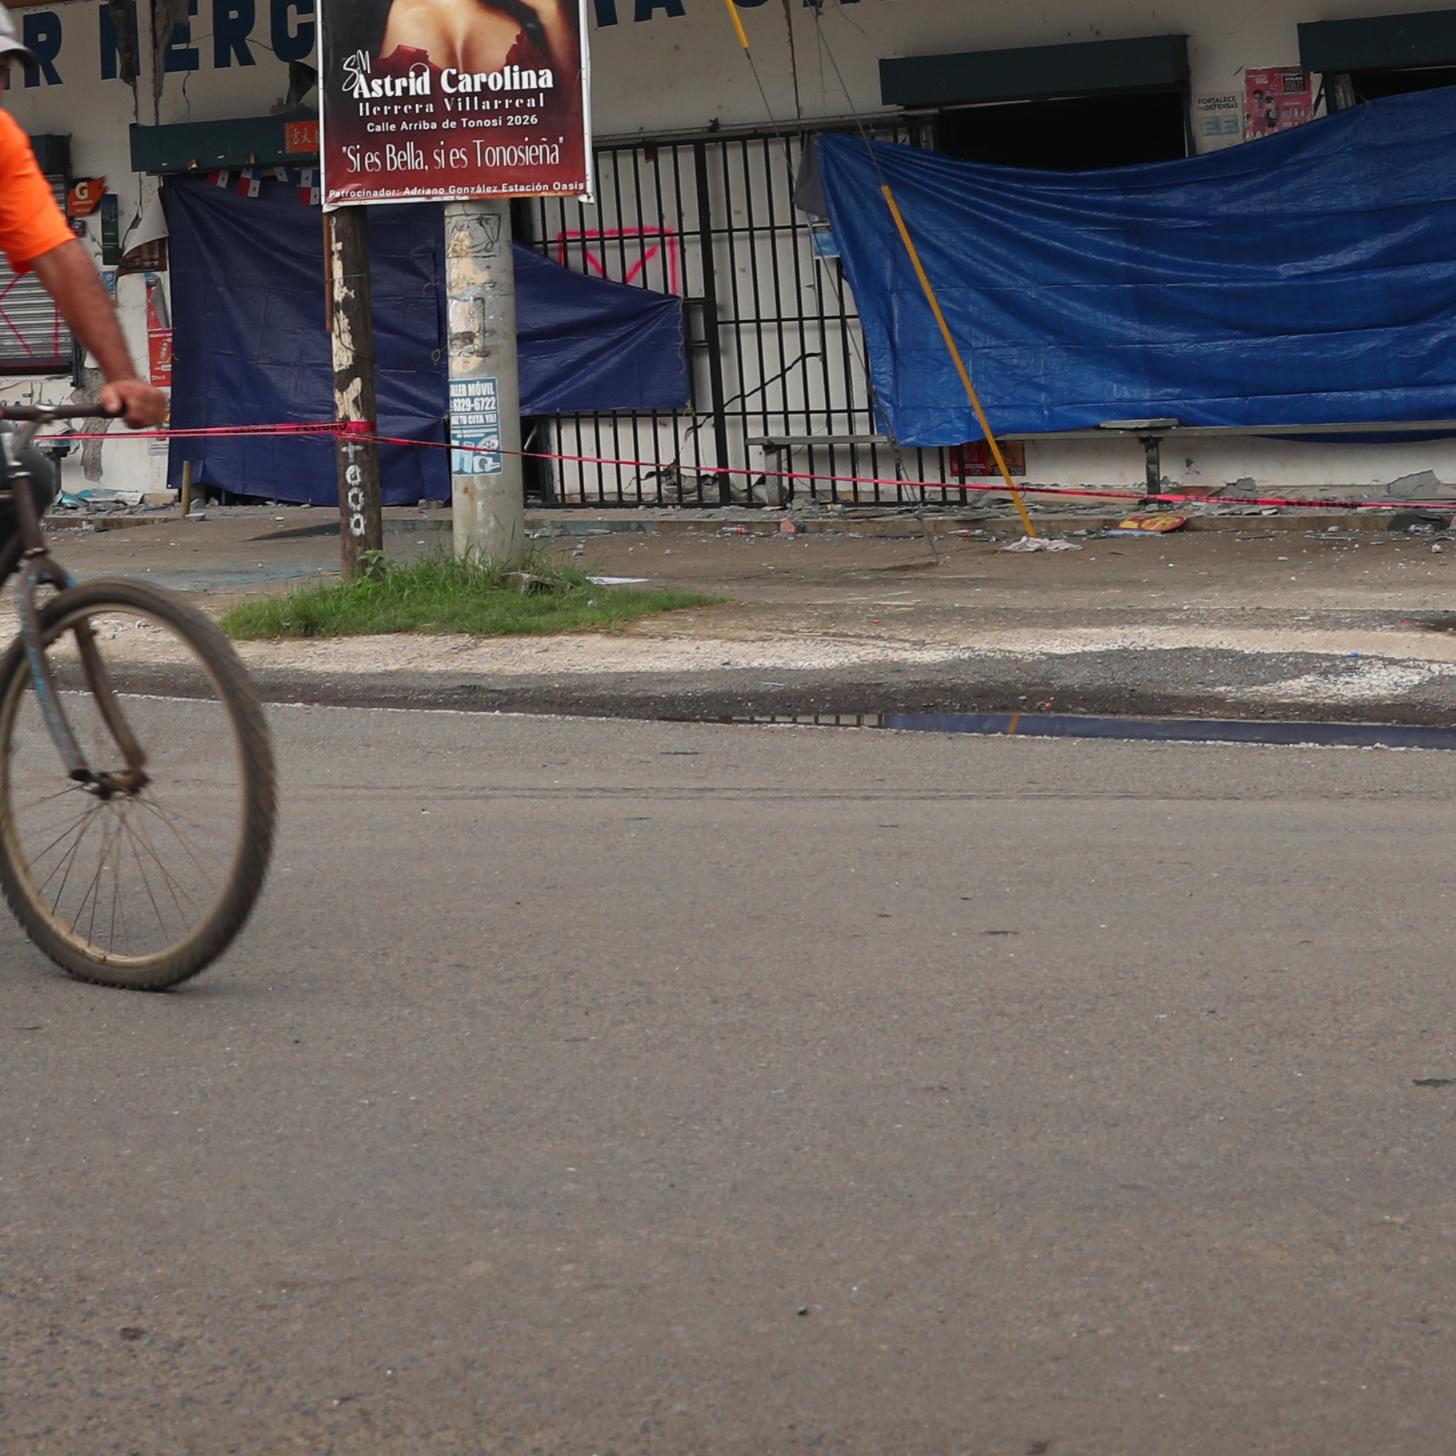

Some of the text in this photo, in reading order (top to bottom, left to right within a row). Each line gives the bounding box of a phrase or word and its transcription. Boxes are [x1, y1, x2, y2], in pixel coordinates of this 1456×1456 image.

[352, 62, 554, 99] Astrid Carolina
[358, 92, 545, 117] Herrera Villarreal
[366, 114, 539, 133] Calle Arriba de Tonosí 2026
[364, 154, 382, 172] es
[386, 141, 430, 172] Bella,
[432, 141, 445, 169] si
[449, 151, 469, 169] es
[329, 179, 585, 199] Patrocinador: Adriano González Estación Oasis
